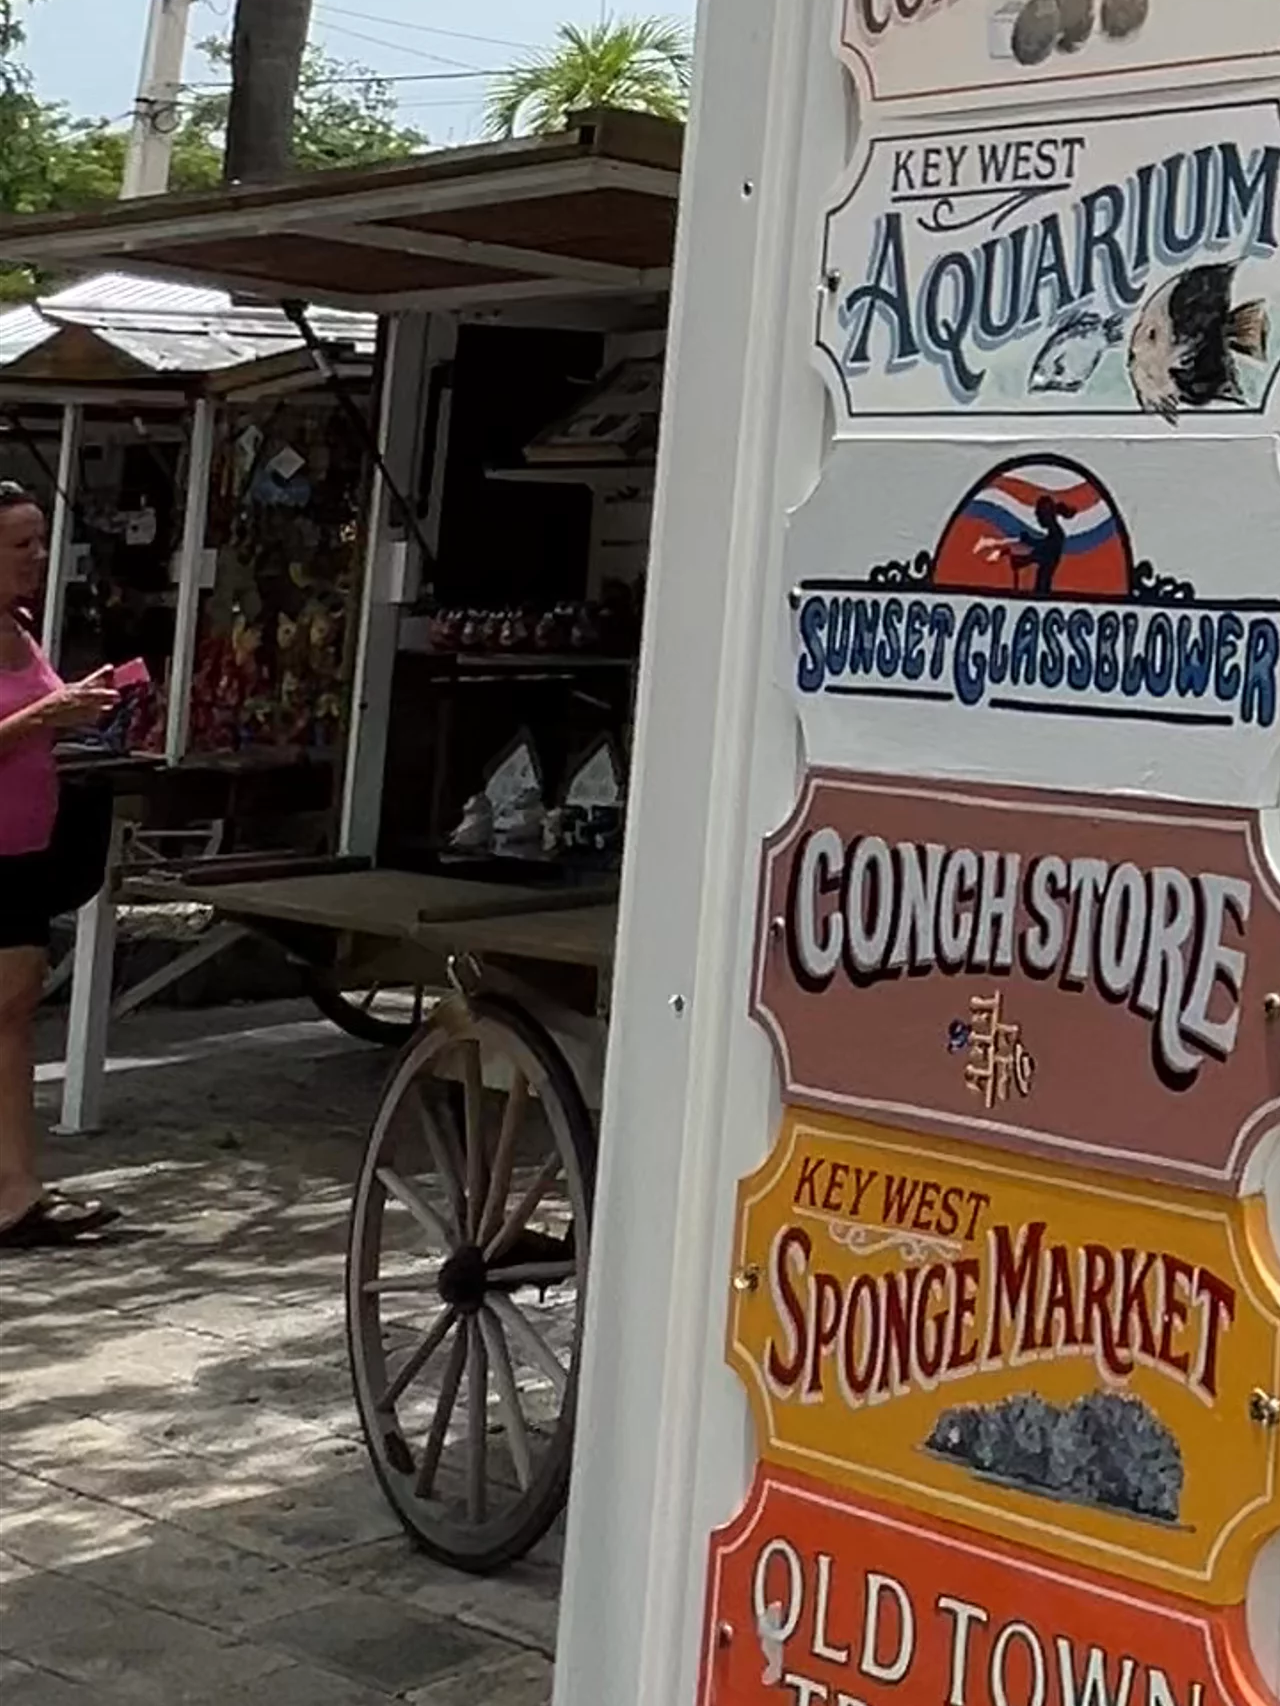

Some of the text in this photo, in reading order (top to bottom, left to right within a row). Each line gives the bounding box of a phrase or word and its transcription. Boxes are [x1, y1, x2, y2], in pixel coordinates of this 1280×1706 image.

[892, 138, 1085, 191] KEY WEST
[796, 596, 1280, 726] SUNSET GLASSBLOWER
[792, 827, 1250, 1078] CONCH STORE
[794, 1157, 990, 1241] KEY WEST
[766, 1221, 1235, 1404] SPONGE MARKET
[753, 1538, 915, 1685] OLD
